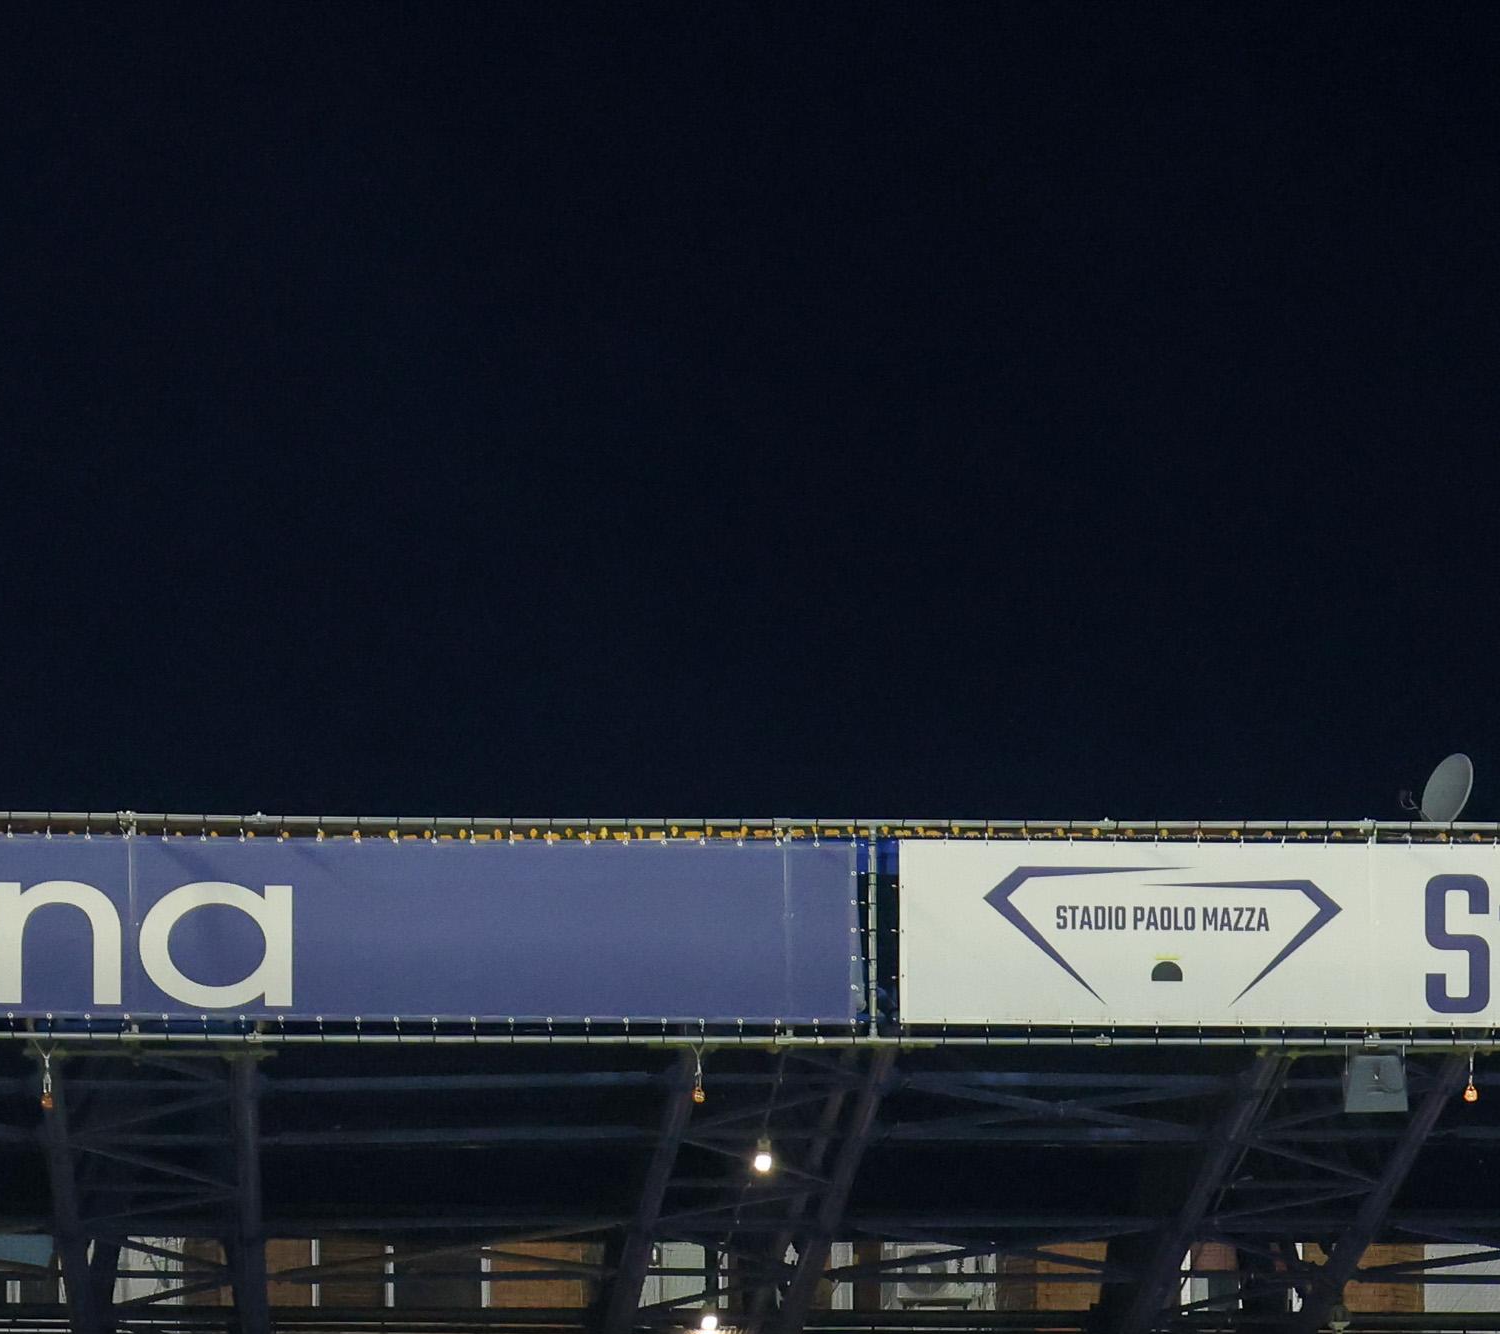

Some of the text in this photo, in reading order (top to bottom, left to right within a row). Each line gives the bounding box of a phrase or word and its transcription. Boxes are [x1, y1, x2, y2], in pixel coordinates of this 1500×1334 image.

[1056, 905, 1270, 932] STADIO PAOLO MAZZA
